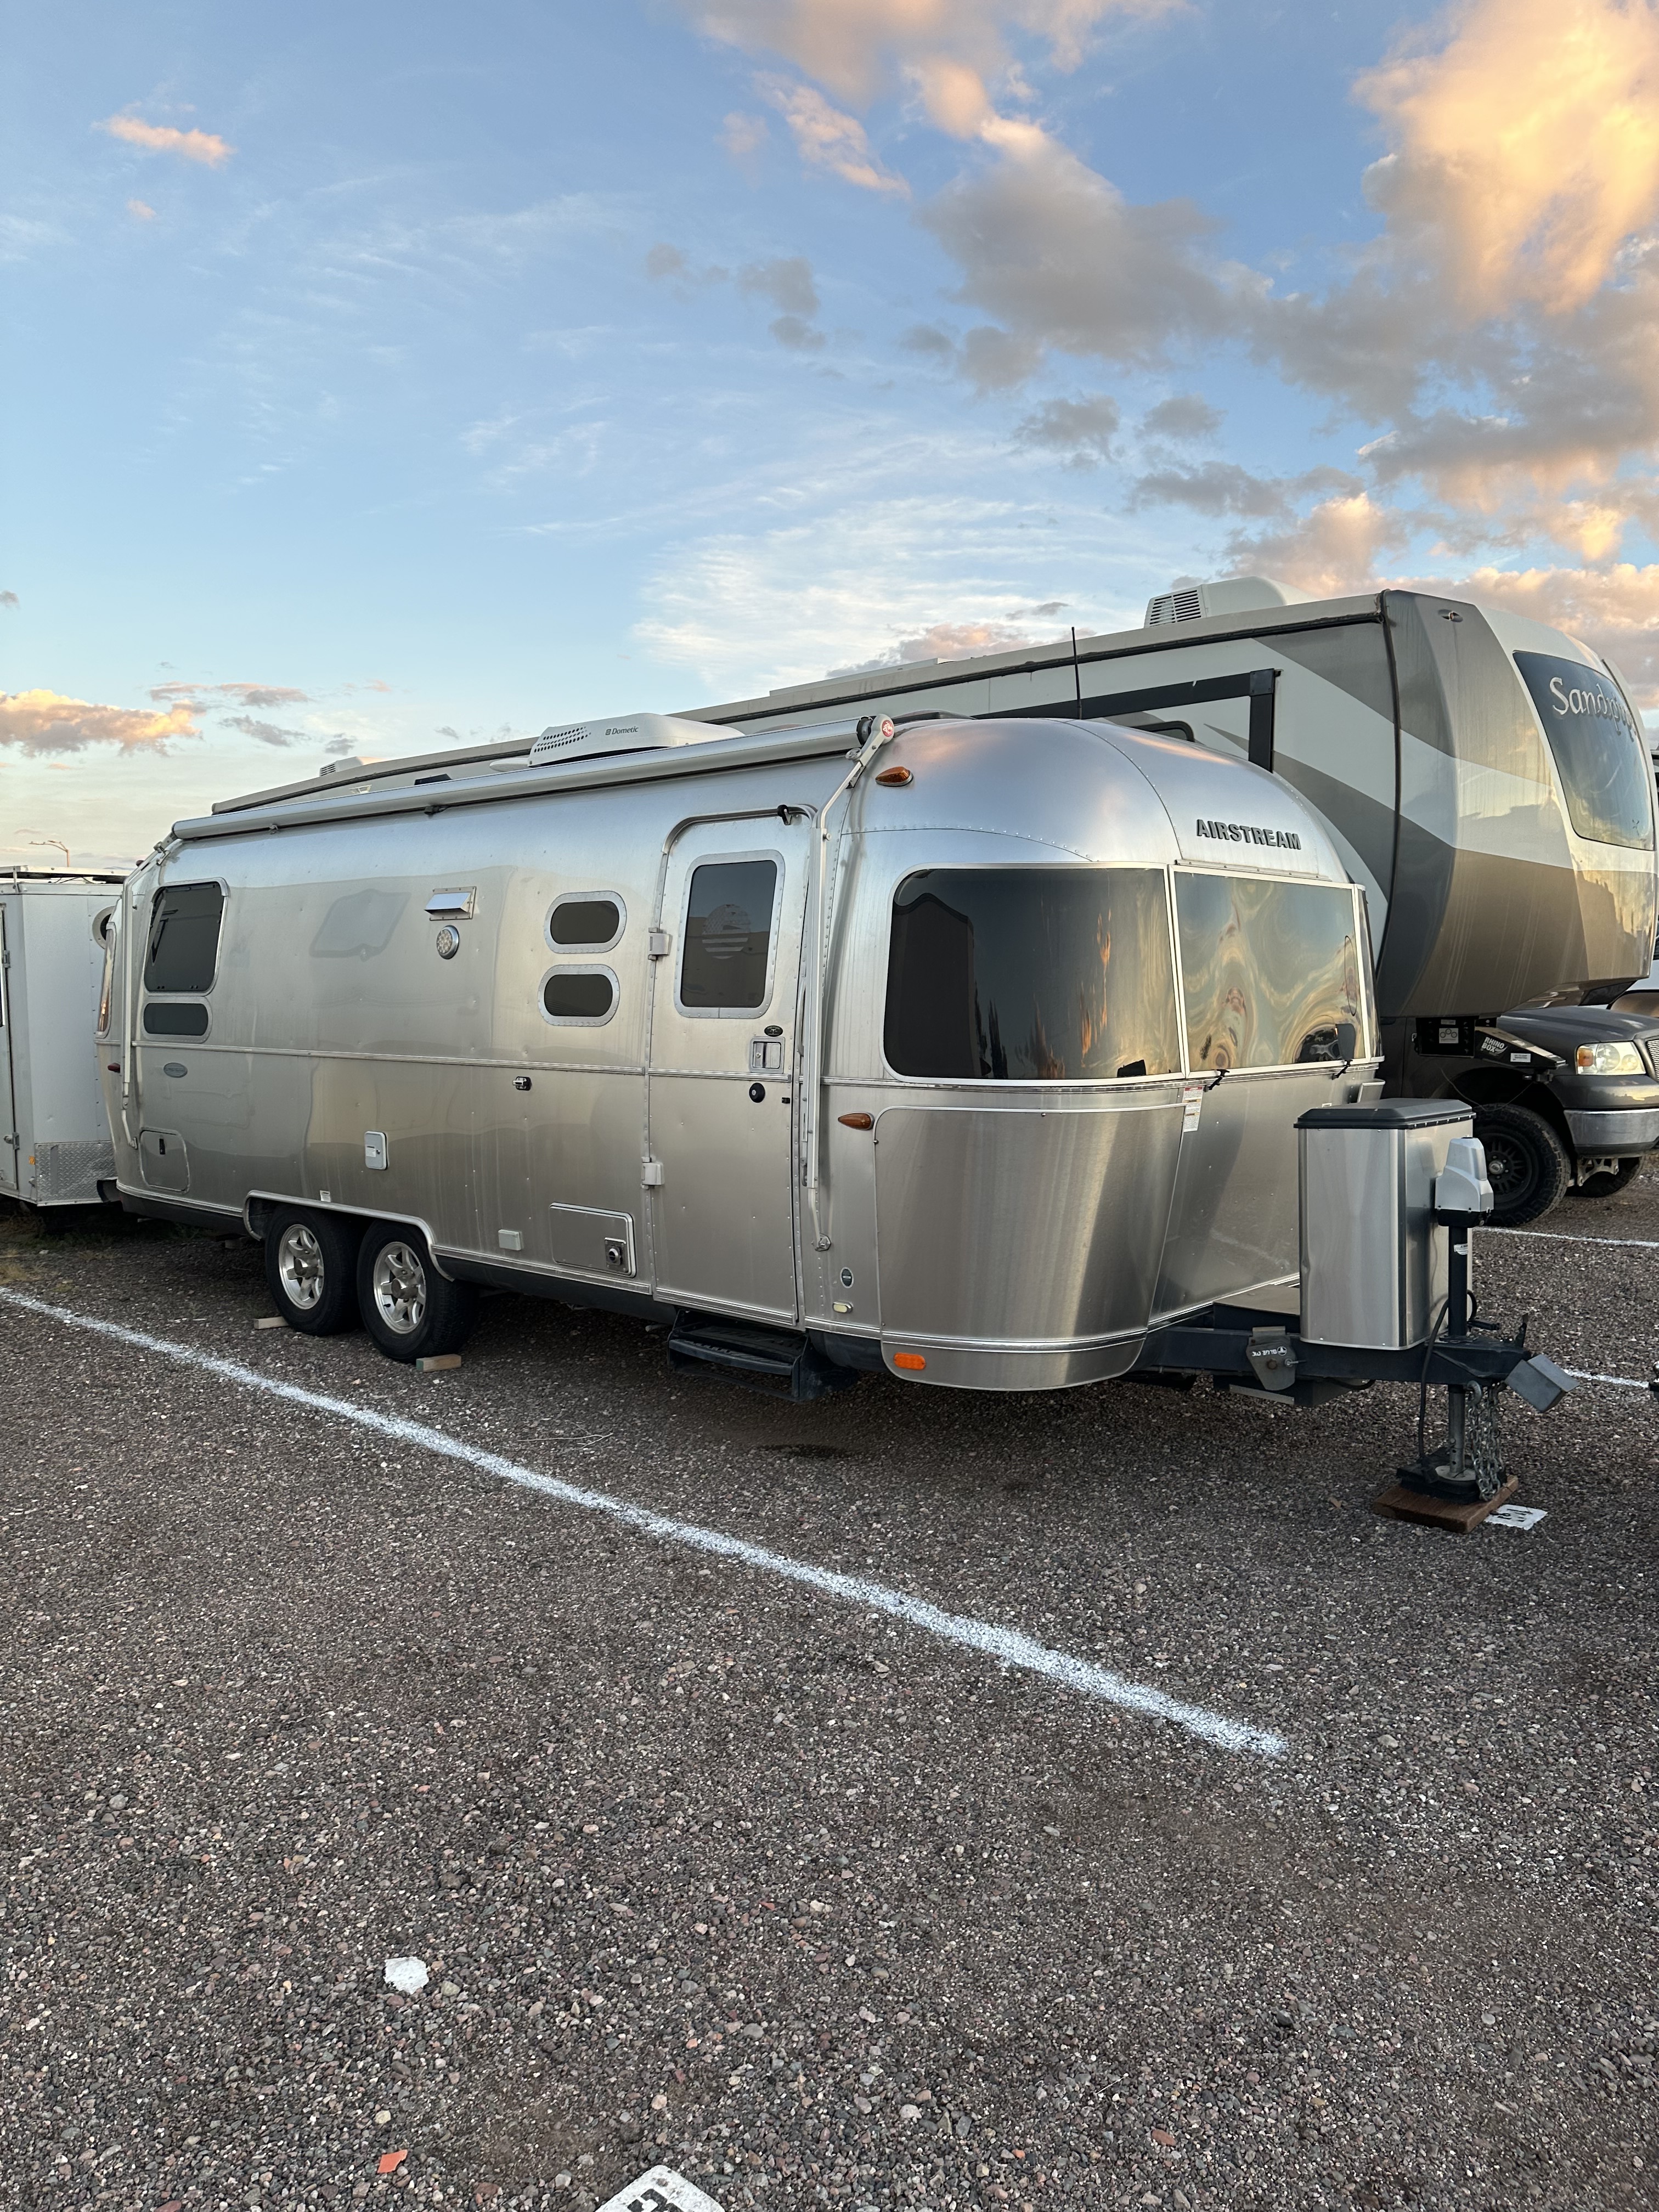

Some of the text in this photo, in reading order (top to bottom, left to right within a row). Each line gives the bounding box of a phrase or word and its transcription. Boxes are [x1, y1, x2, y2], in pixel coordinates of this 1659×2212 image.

[612, 726, 639, 735] Dometic
[1197, 819, 1301, 850] AIRSTREAM
[1481, 1042, 1497, 1053] BOX
[1484, 1036, 1505, 1049] RHINO
